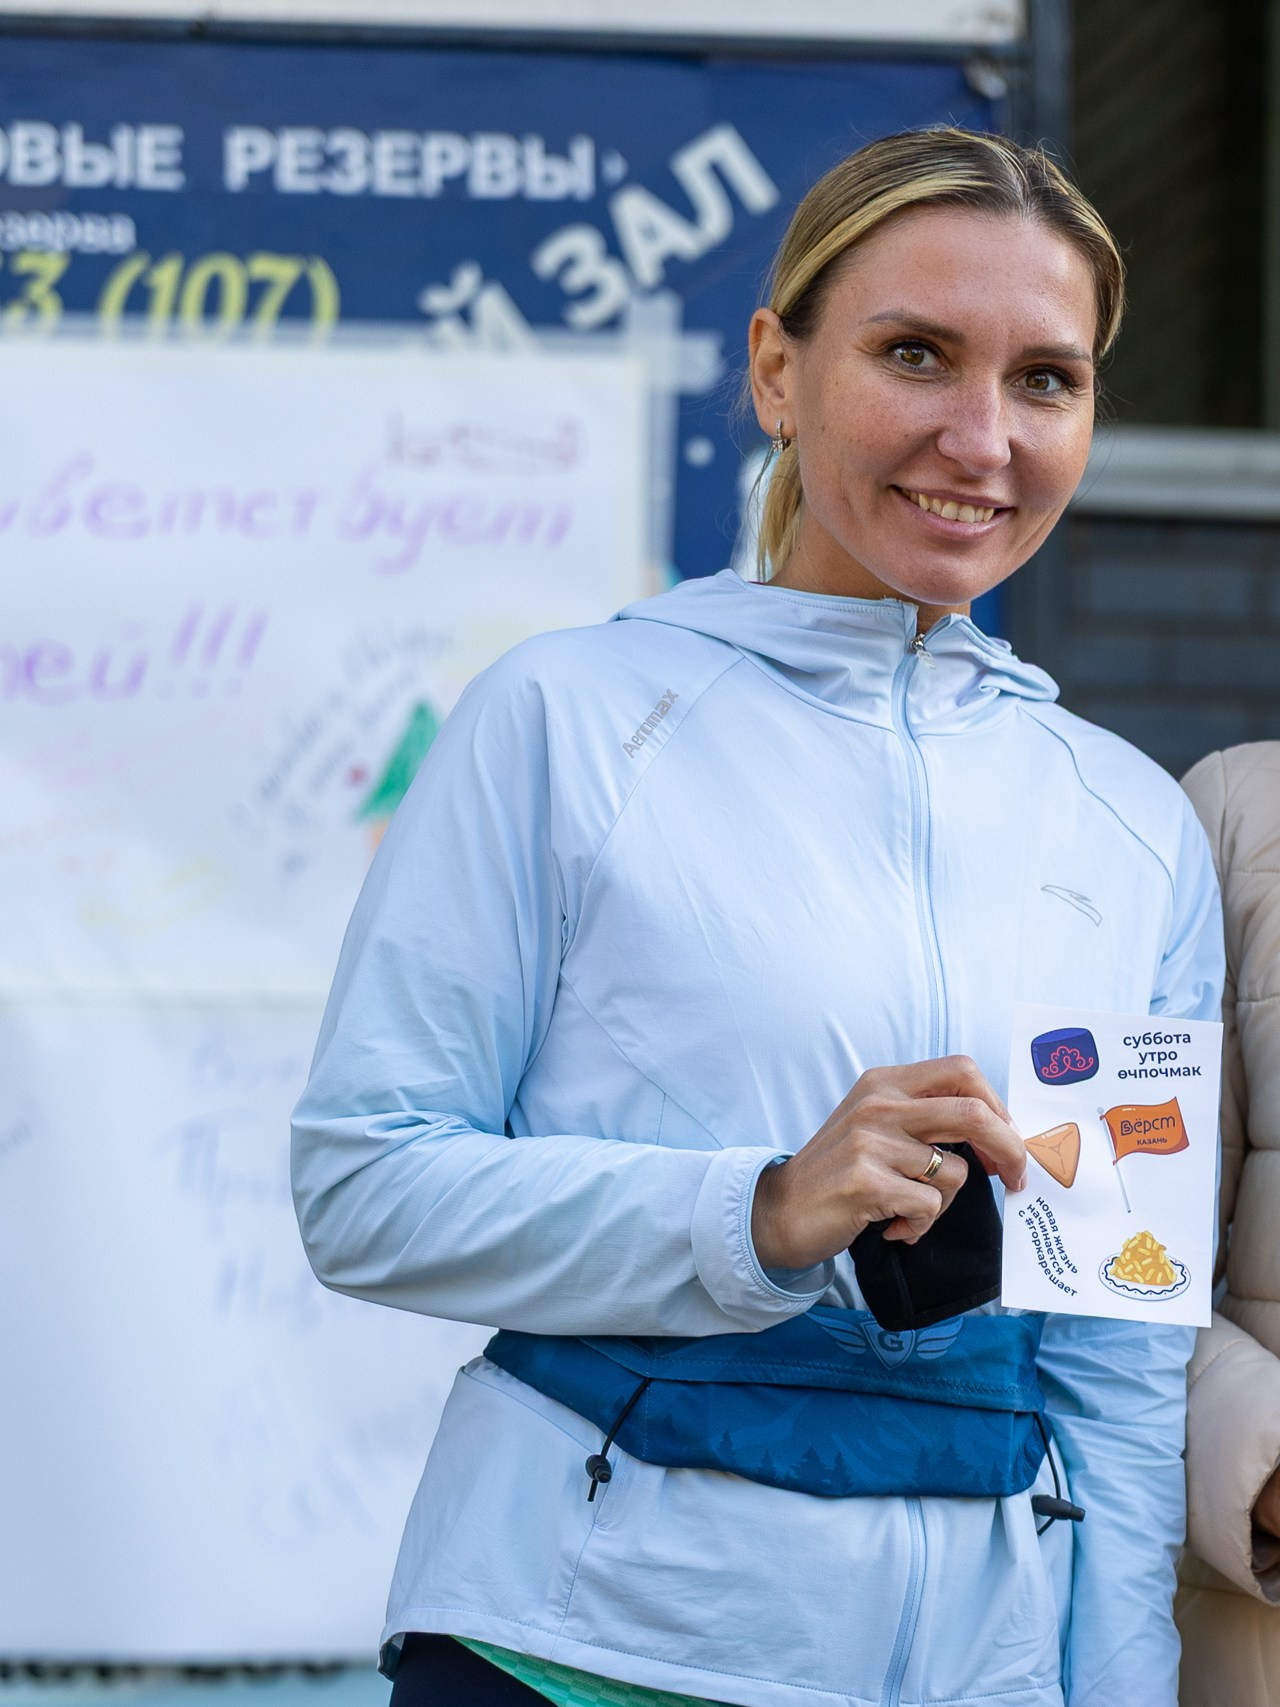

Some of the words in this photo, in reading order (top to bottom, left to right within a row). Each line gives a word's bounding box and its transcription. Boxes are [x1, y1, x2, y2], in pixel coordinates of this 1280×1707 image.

[0, 120, 187, 192] ВЫЕ
[622, 688, 680, 760] Aeromax
[1122, 1031, 1192, 1049] суббота
[1138, 1050, 1178, 1065] утро
[1120, 1115, 1176, 1136] Вёрст
[1136, 1137, 1168, 1146] КАЗАНЬ
[1018, 1209, 1026, 1218] с
[1025, 1217, 1078, 1297] #горкарешает
[1026, 1203, 1065, 1276] начинается
[1035, 1196, 1059, 1233] новая
[1053, 1235, 1078, 1274] жизнь
[877, 1330, 905, 1353] G
